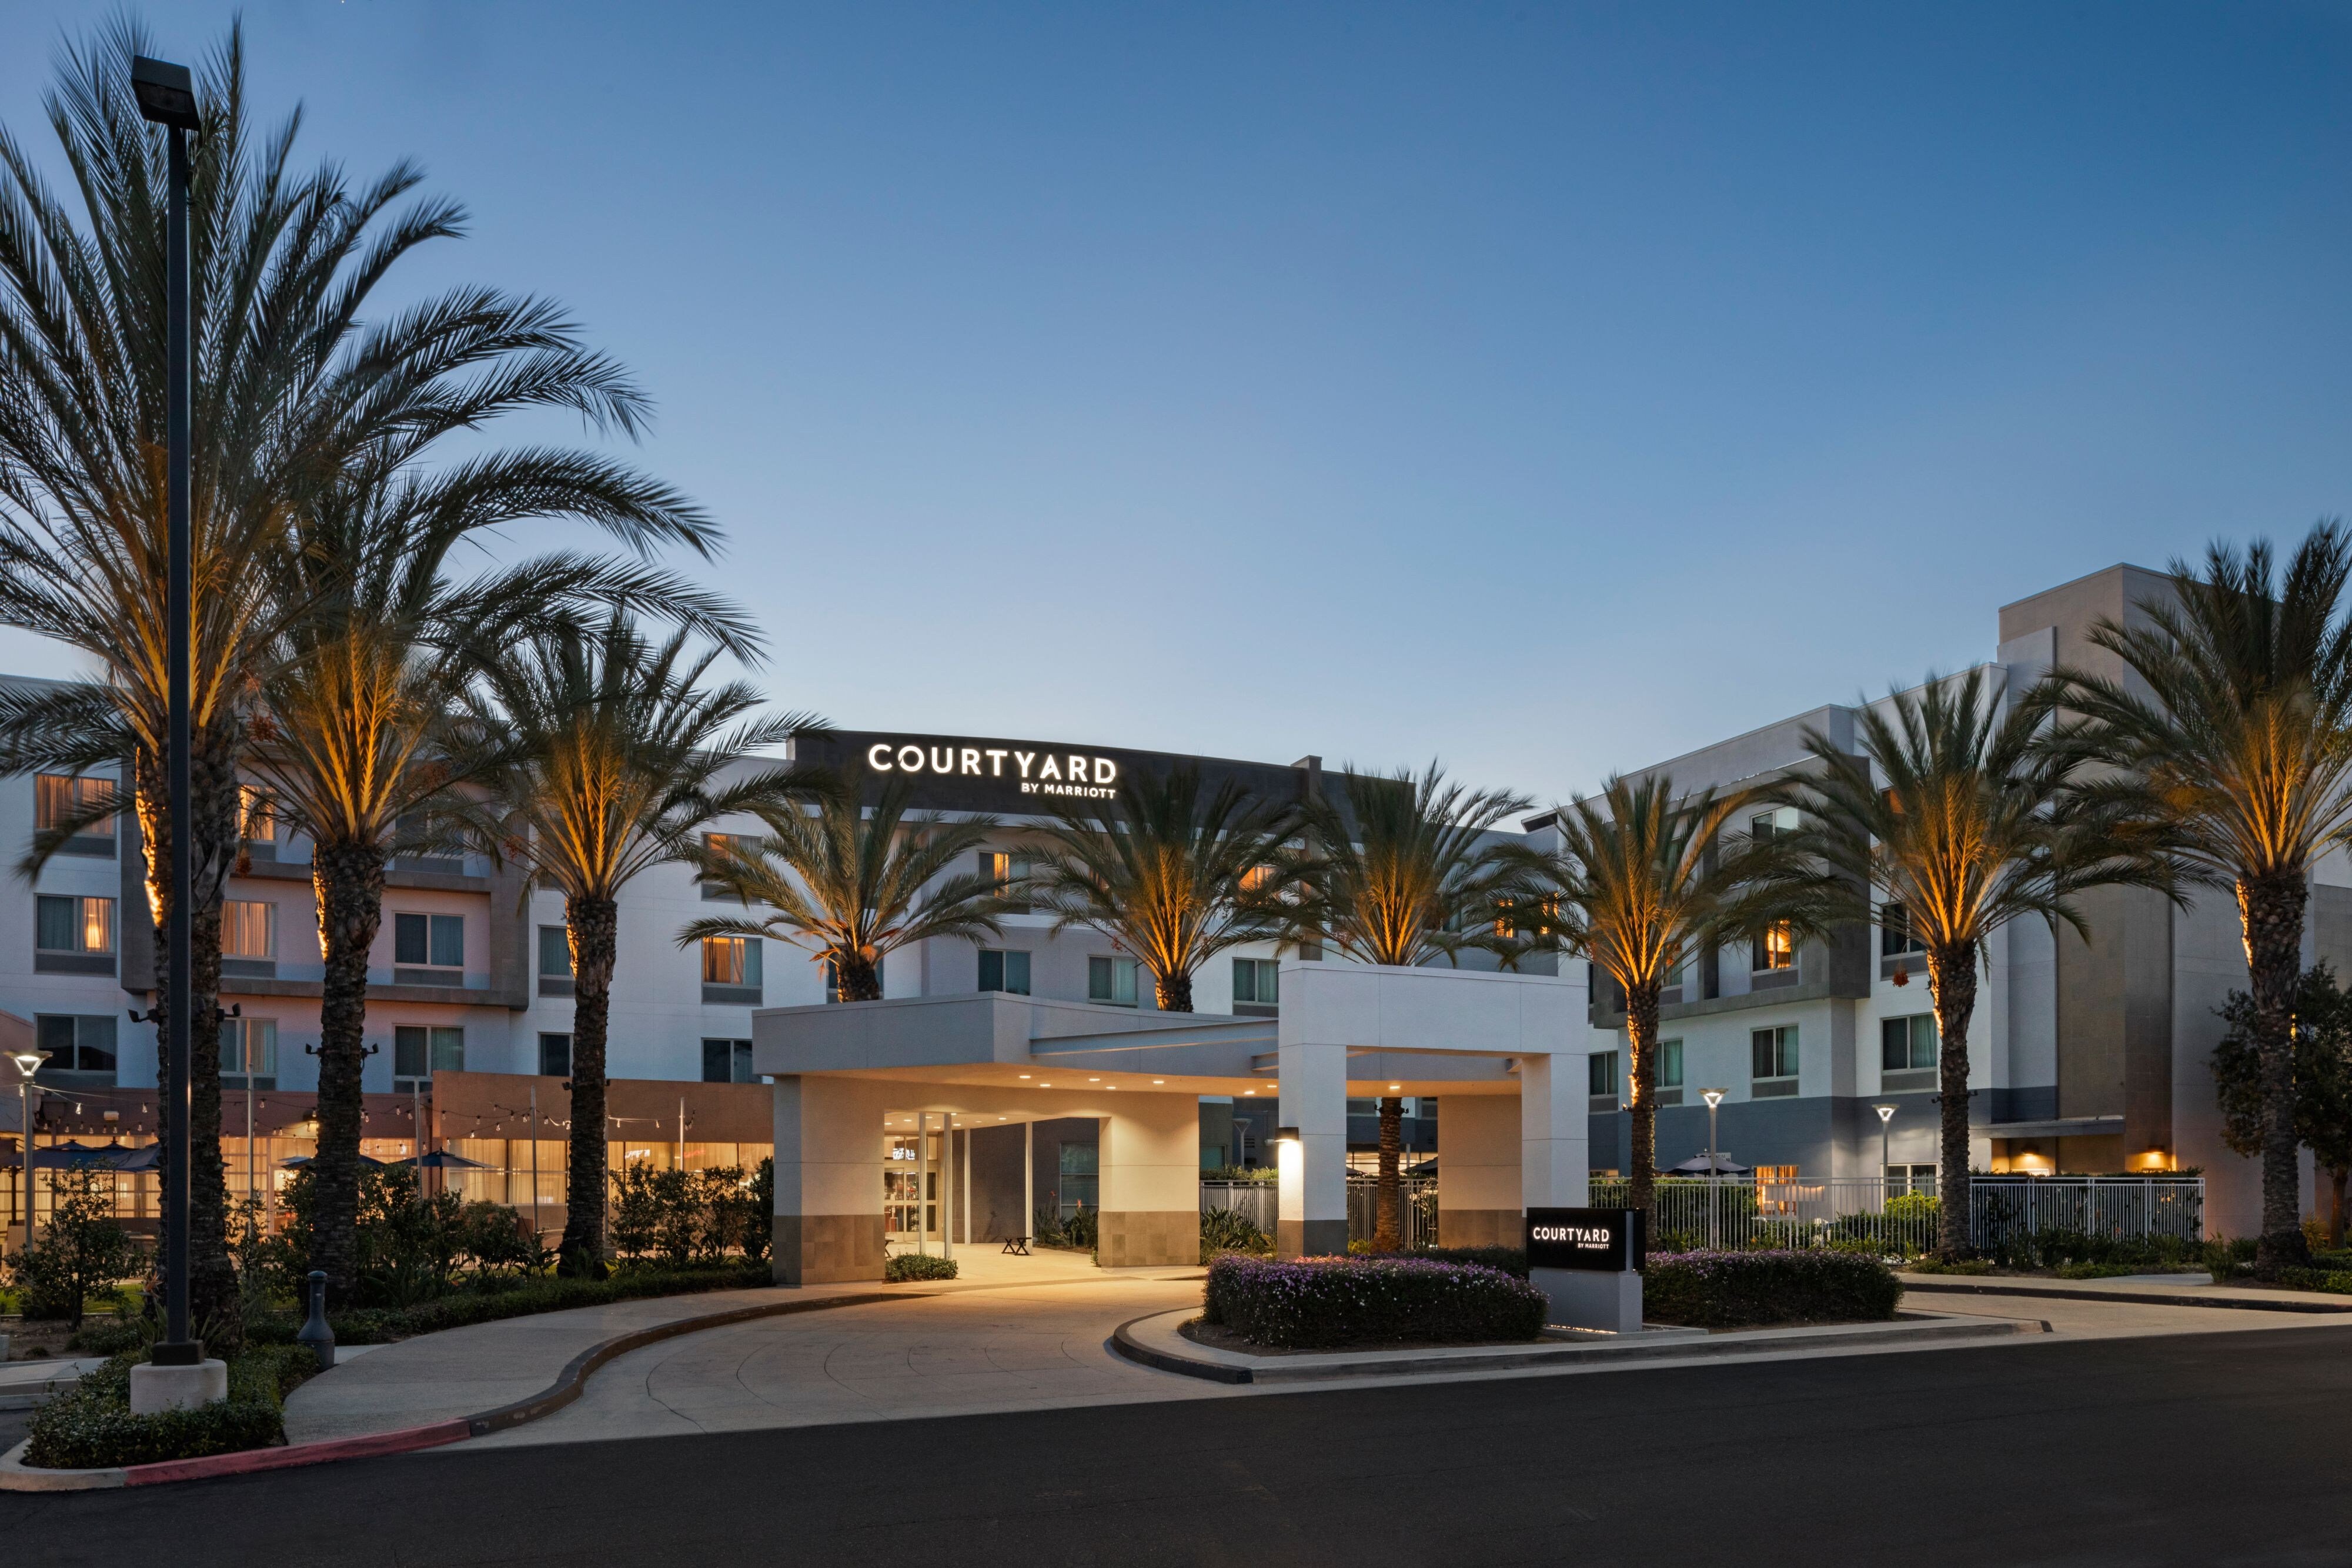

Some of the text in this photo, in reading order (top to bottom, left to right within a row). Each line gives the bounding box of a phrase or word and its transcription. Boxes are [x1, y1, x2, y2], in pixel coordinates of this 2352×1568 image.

[868, 744, 1117, 784] COURTYARD
[1021, 783, 1116, 800] BY MARRIOTT
[1533, 1226, 1610, 1242] COURTYARD
